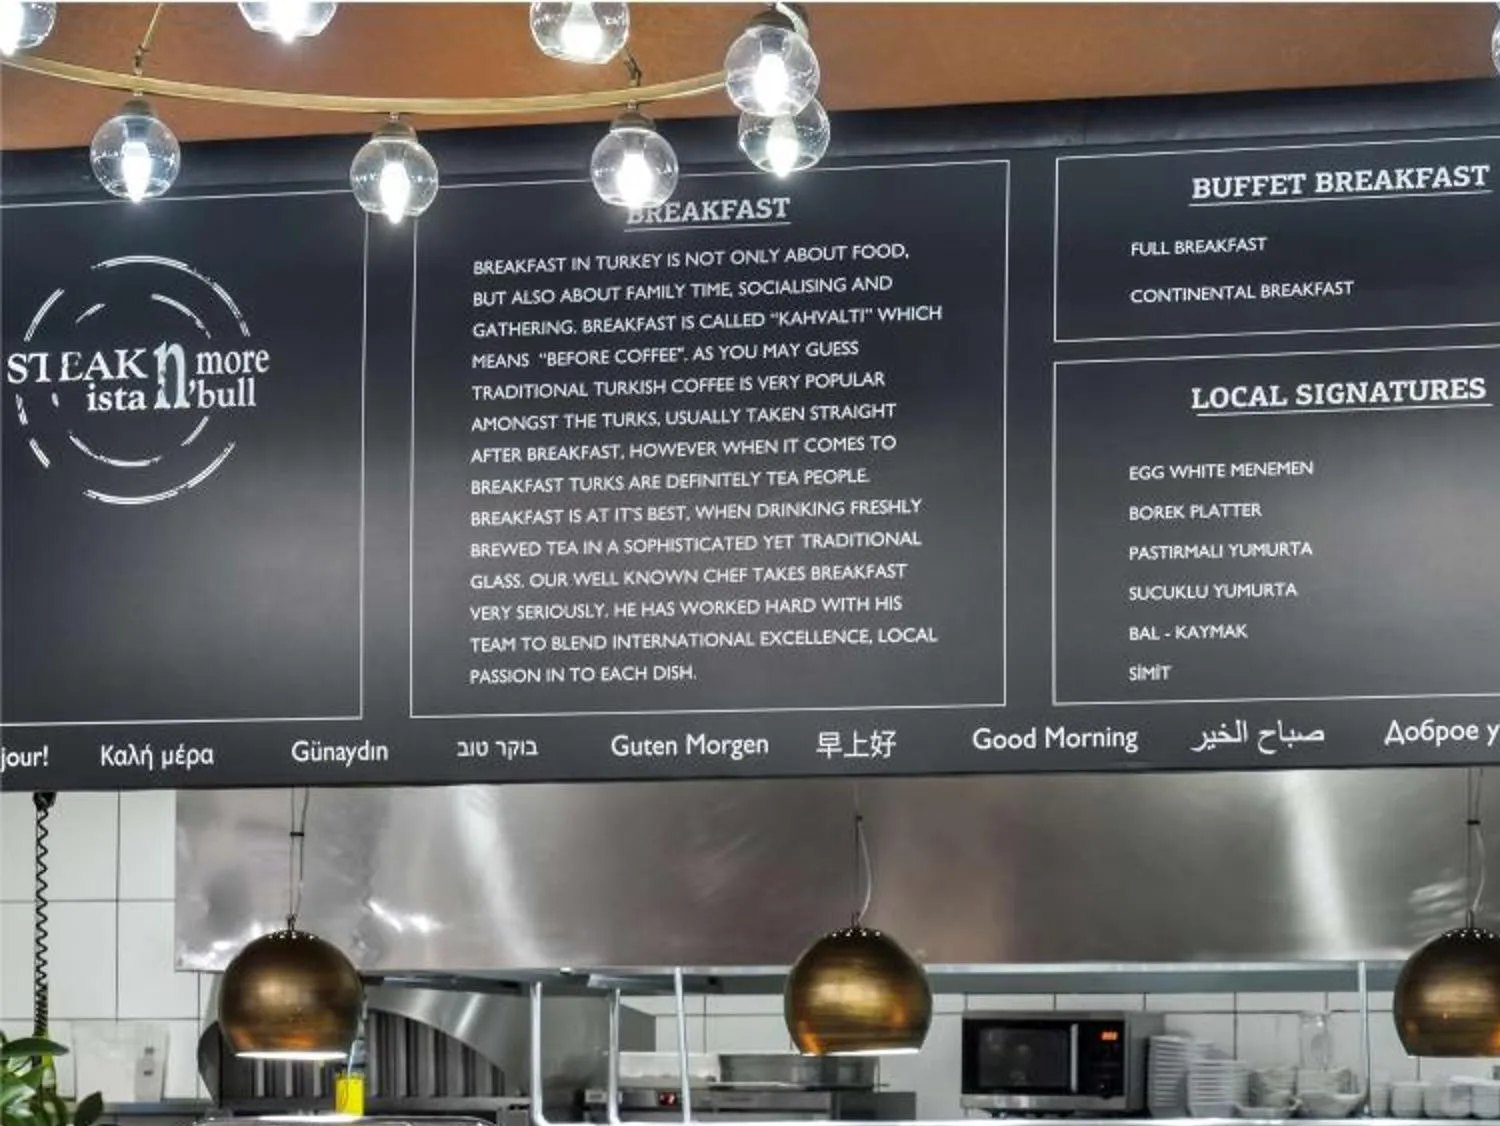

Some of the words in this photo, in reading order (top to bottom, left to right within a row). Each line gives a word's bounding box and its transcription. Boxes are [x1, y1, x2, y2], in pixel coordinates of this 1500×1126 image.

[1191, 172, 1307, 199] BUFFET
[1314, 164, 1491, 192] BREAKFAST
[626, 197, 791, 225] BREAKFAST
[473, 256, 567, 276] BREAKFAST
[571, 255, 591, 271] IN
[595, 253, 663, 271] TURKEY
[667, 252, 681, 268] IS
[685, 250, 726, 267] NOT
[729, 248, 781, 265] ONLY
[783, 245, 849, 263] ABOUT
[1130, 241, 1171, 257] FULL
[1174, 236, 1268, 255] BREAKFAST
[473, 290, 507, 307] BUT
[511, 288, 556, 305] ALSO
[559, 286, 622, 303] ABOUT
[626, 283, 686, 301] FAMILY
[738, 276, 847, 297] SOCIALISING
[851, 274, 893, 292] AND
[1130, 284, 1257, 304] CONTINENTAL
[1260, 280, 1355, 299] BREAKFAST
[581, 314, 677, 335] BREAKFAST
[681, 314, 695, 330] IS
[699, 312, 766, 329] CALLED
[876, 305, 943, 322] WHICH
[471, 383, 589, 401] TRADITIONAL
[593, 379, 667, 397] TURKISH
[671, 376, 735, 394] COFFEE
[739, 375, 753, 392] IS
[757, 374, 801, 391] VERY
[805, 371, 886, 389] POPULAR
[1191, 385, 1288, 410] LOCAL
[1295, 377, 1487, 405] SIGNATURES
[471, 414, 559, 432] AMONGST
[563, 412, 597, 429] THE
[665, 408, 741, 426] USUALLY
[745, 406, 805, 423] TAKEN
[809, 402, 897, 421] STRAIGHT
[470, 447, 523, 463] AFTER
[629, 440, 717, 459] HOWEVER
[721, 439, 779, 455] WHEN
[783, 437, 800, 454] IT
[803, 435, 865, 453] COMES
[869, 434, 897, 451] TO
[1129, 465, 1165, 481] EGG
[1169, 463, 1226, 479] WHITE
[1230, 460, 1314, 478] MENEMEN
[1129, 504, 1186, 521] BOREK
[1189, 502, 1263, 519] PLATTER
[470, 540, 542, 558] BREWED
[545, 540, 579, 556] TEA
[583, 539, 603, 555] IN
[606, 539, 620, 555] A
[623, 535, 759, 555] SOPHISTICATED
[762, 533, 795, 550] YET
[800, 530, 923, 549] TRADITIONAL
[1129, 543, 1224, 561] PASTIRMALI
[1227, 541, 1313, 558] YUMURTA
[529, 572, 569, 589] OUR
[572, 571, 620, 587] WELL
[623, 569, 699, 586] KNOWN
[703, 567, 749, 584] CHEF
[751, 565, 807, 583] TAKES
[810, 562, 909, 581] BREAKFAST
[1128, 584, 1209, 602] SUCUKLU
[1212, 582, 1298, 599] YUMURTA
[469, 637, 517, 653] TEAM
[519, 636, 547, 652] TO
[551, 634, 608, 651] BLEND
[612, 631, 756, 650] INTERNATIONAL
[877, 627, 939, 644] LOCAL
[1128, 625, 1161, 641] BAL
[1175, 623, 1249, 640] KAYMAK
[469, 668, 542, 685] PASSION
[545, 667, 565, 683] IN
[568, 666, 596, 683] TO
[600, 665, 648, 682] EACH
[815, 729, 897, 760] 早上好
[972, 726, 1037, 750] Good
[1044, 725, 1139, 754] Morning
[1190, 719, 1249, 753] الخير
[1257, 719, 1325, 755] صباح
[1383, 718, 1479, 747] Доброе
[100, 743, 153, 771] Καλή
[161, 743, 215, 770] μέρα
[456, 740, 489, 758] טוב
[494, 739, 539, 761] בוקר
[610, 734, 678, 757] Guten
[685, 733, 769, 761] Morgen
